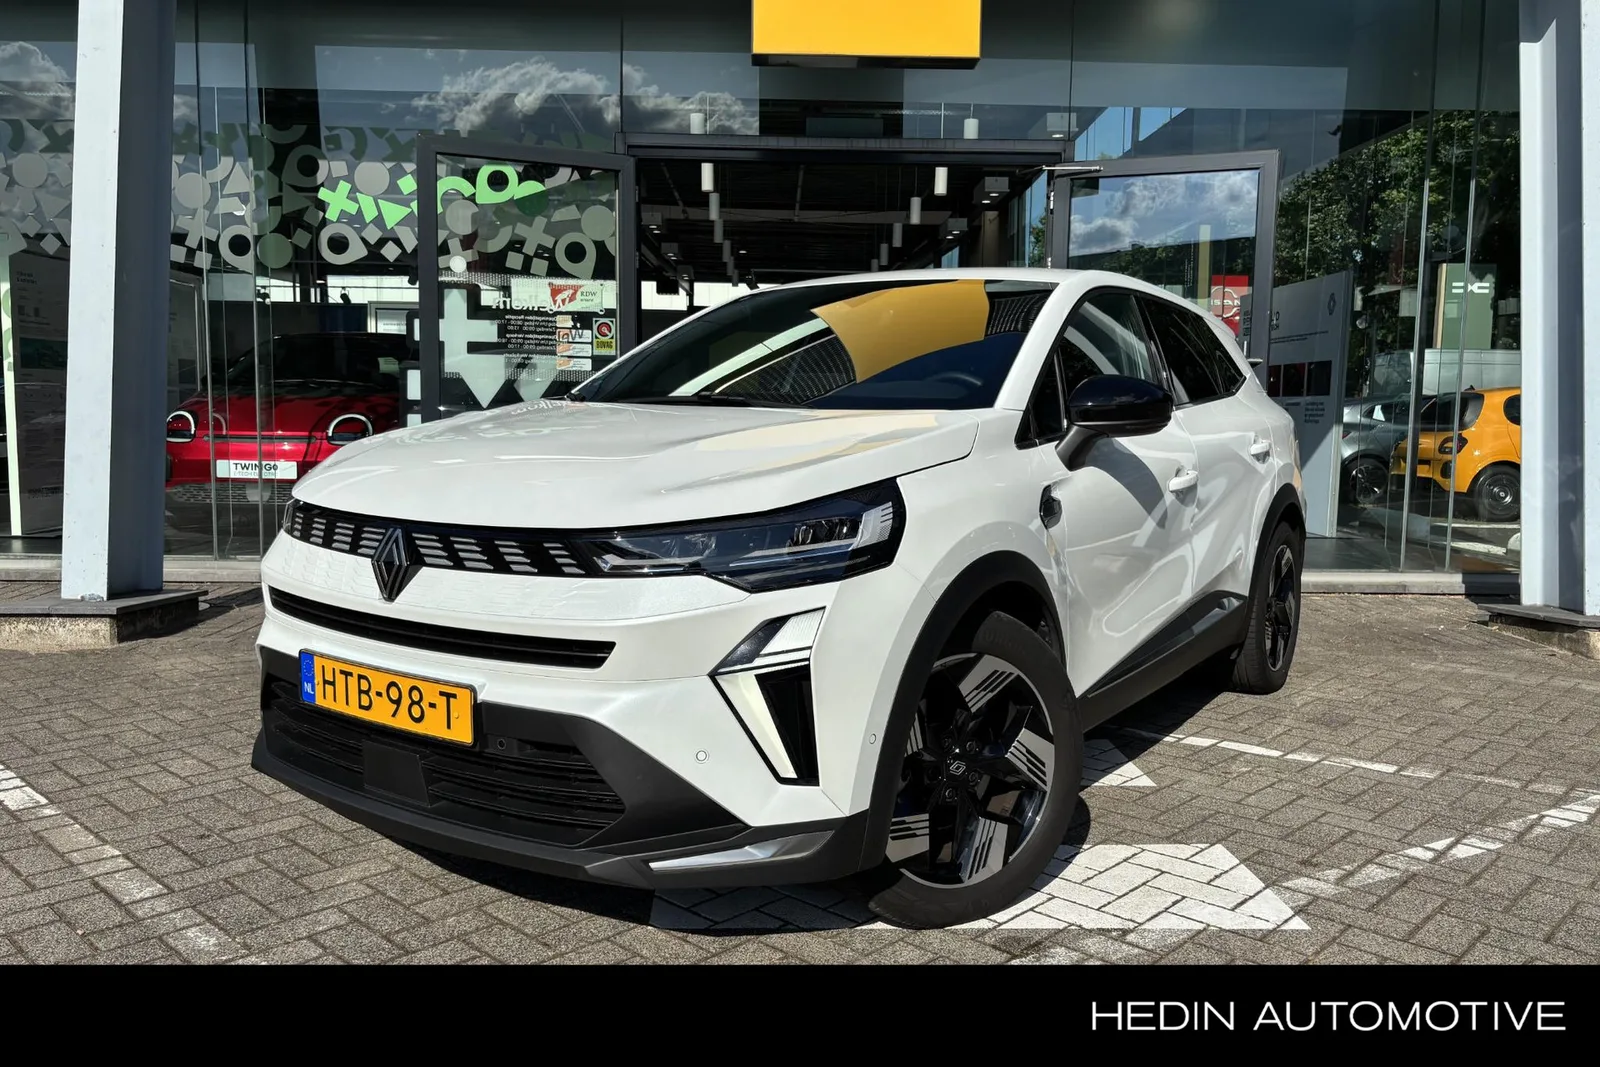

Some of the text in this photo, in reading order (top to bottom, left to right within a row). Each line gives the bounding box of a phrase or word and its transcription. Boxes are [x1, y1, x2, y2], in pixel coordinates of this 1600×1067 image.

[596, 340, 613, 349] BOVAG
[232, 462, 279, 471] TWINGO
[304, 682, 315, 695] NL
[321, 664, 458, 730] HTB-98-T
